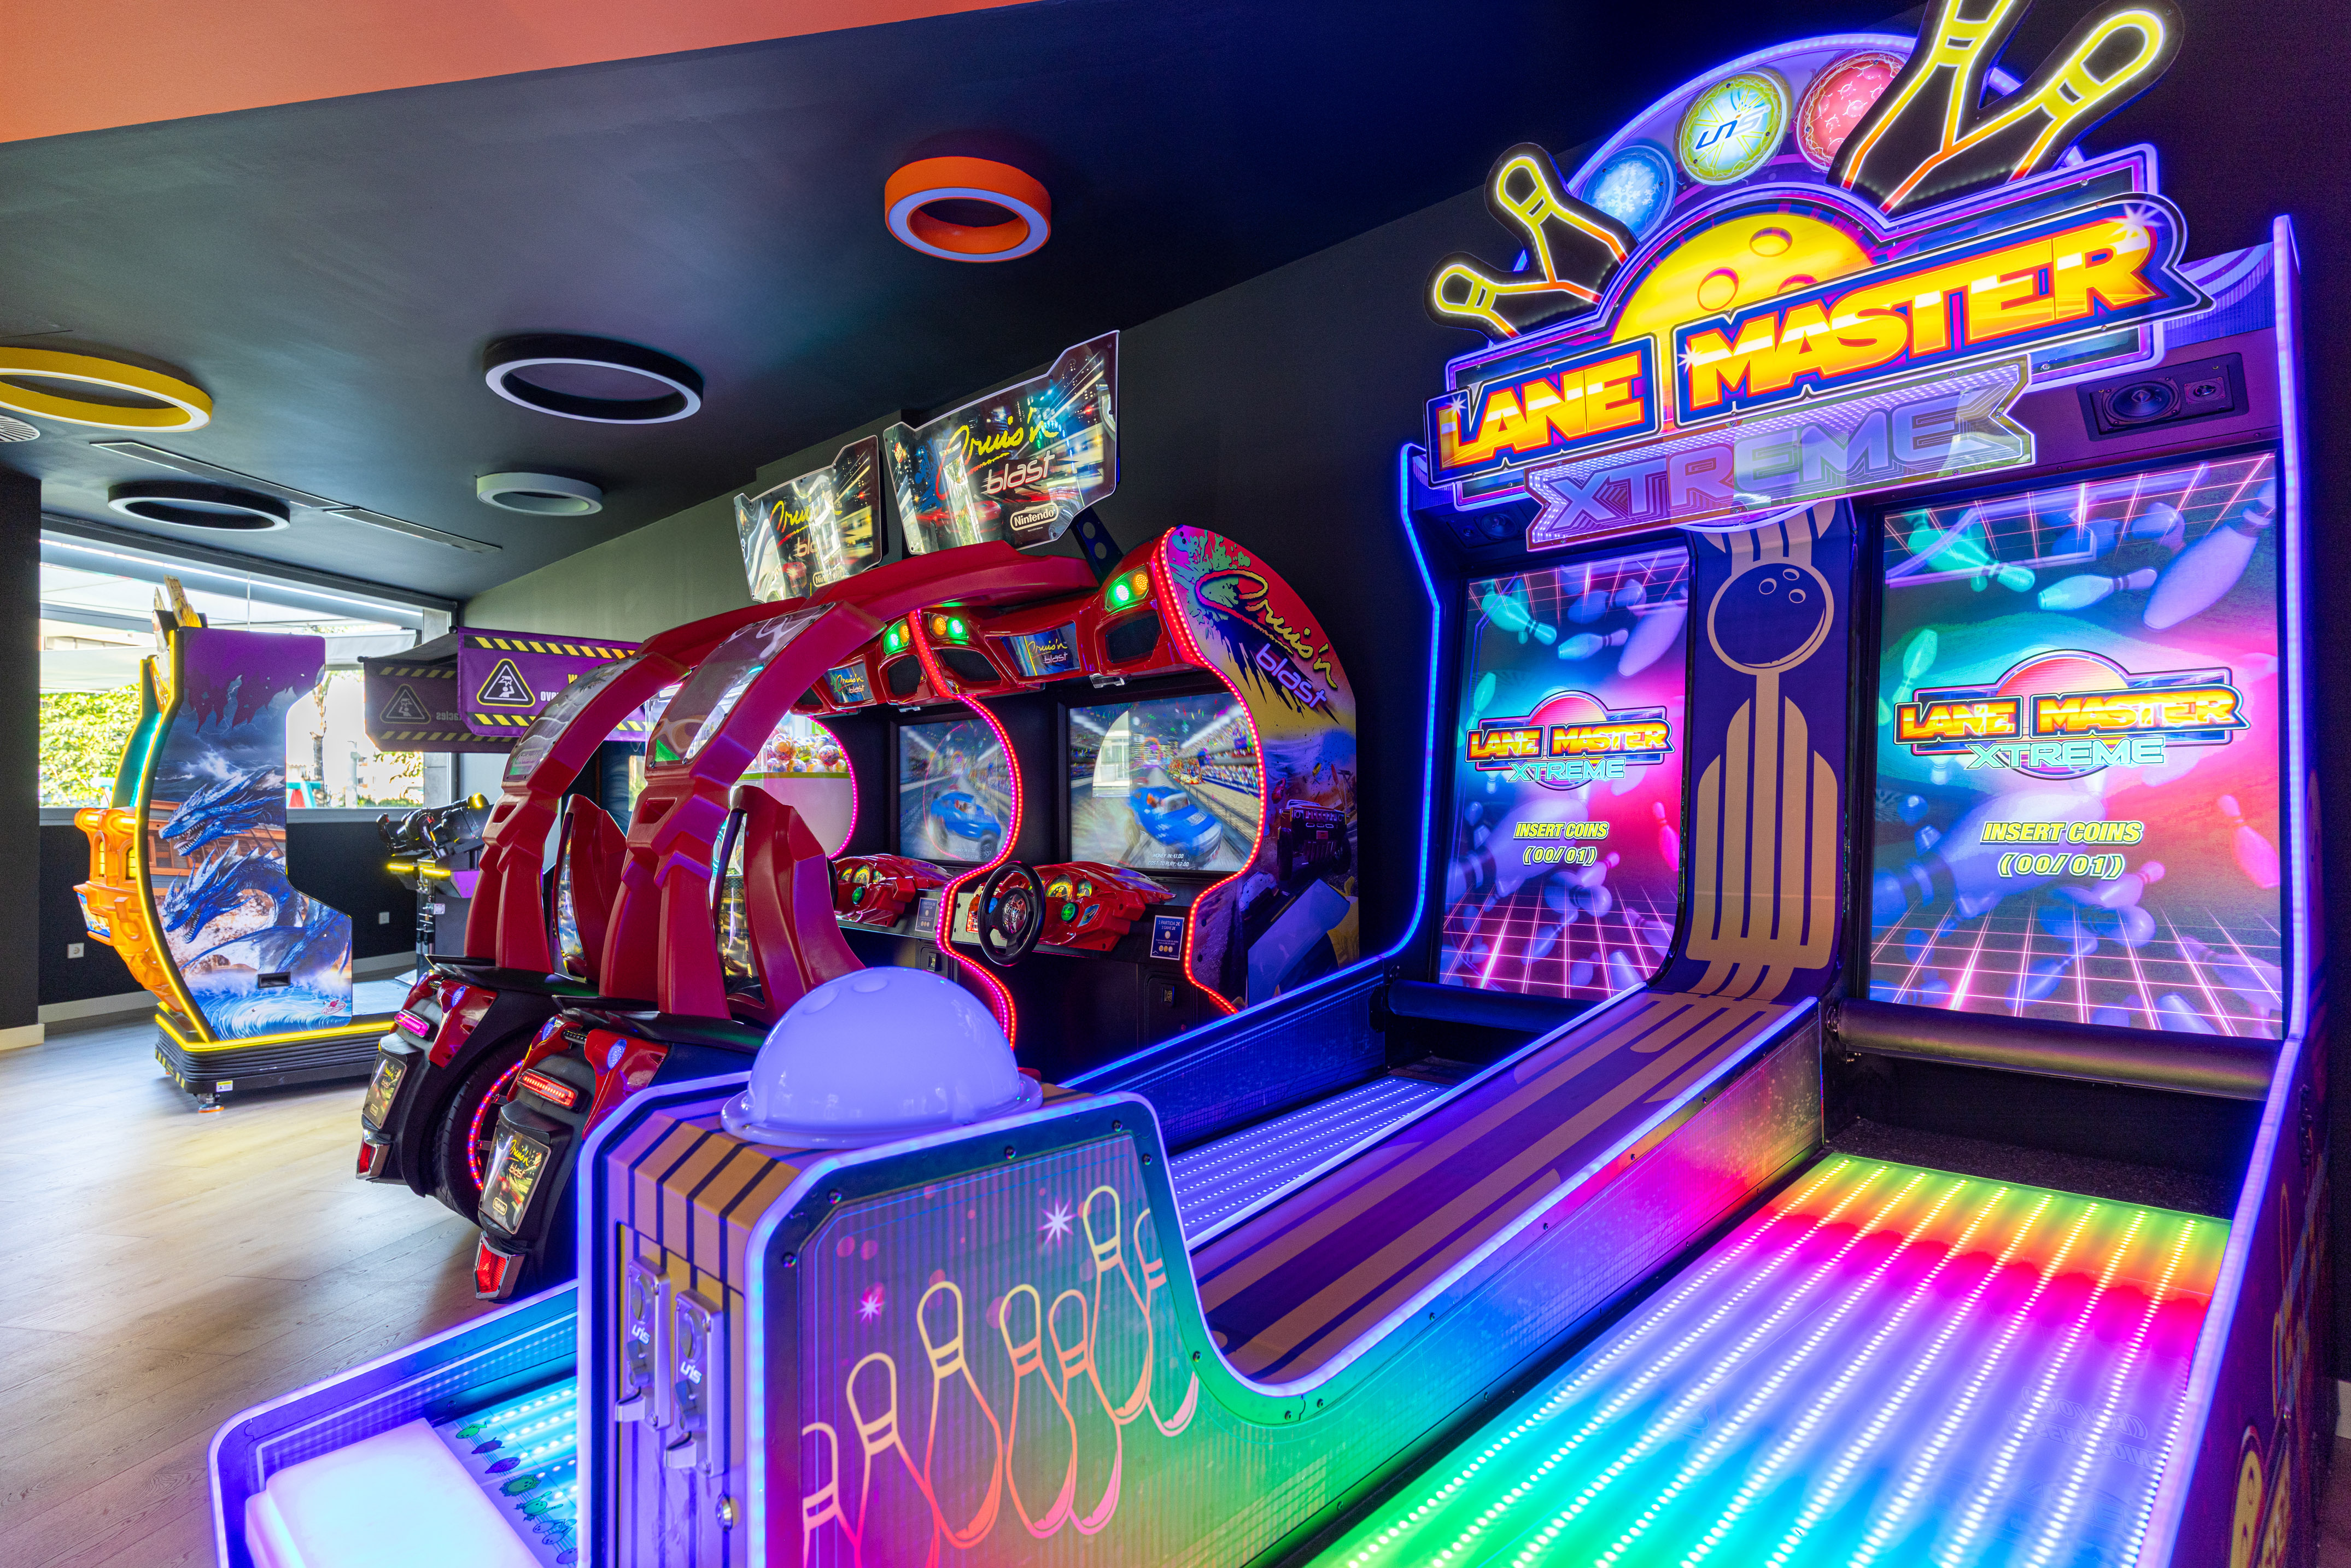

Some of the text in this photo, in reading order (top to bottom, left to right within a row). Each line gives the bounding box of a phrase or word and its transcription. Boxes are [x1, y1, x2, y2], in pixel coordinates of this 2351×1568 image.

[1439, 215, 2168, 471] LANE MASTER
[986, 450, 1056, 494] blast
[1547, 384, 1996, 529] XTREME
[1014, 508, 1054, 526] Nintendo
[1043, 652, 1068, 664] blast
[849, 684, 864, 693] blast
[1256, 643, 1327, 708] blast
[1898, 688, 2241, 740] LANE MASTER
[1469, 722, 1668, 758] LANE MASTER
[1964, 737, 2165, 770] XTREME
[1507, 758, 1626, 782] XTREME
[1514, 822, 1610, 839] INSERT COINS
[1980, 821, 2144, 845] INSERT COINS
